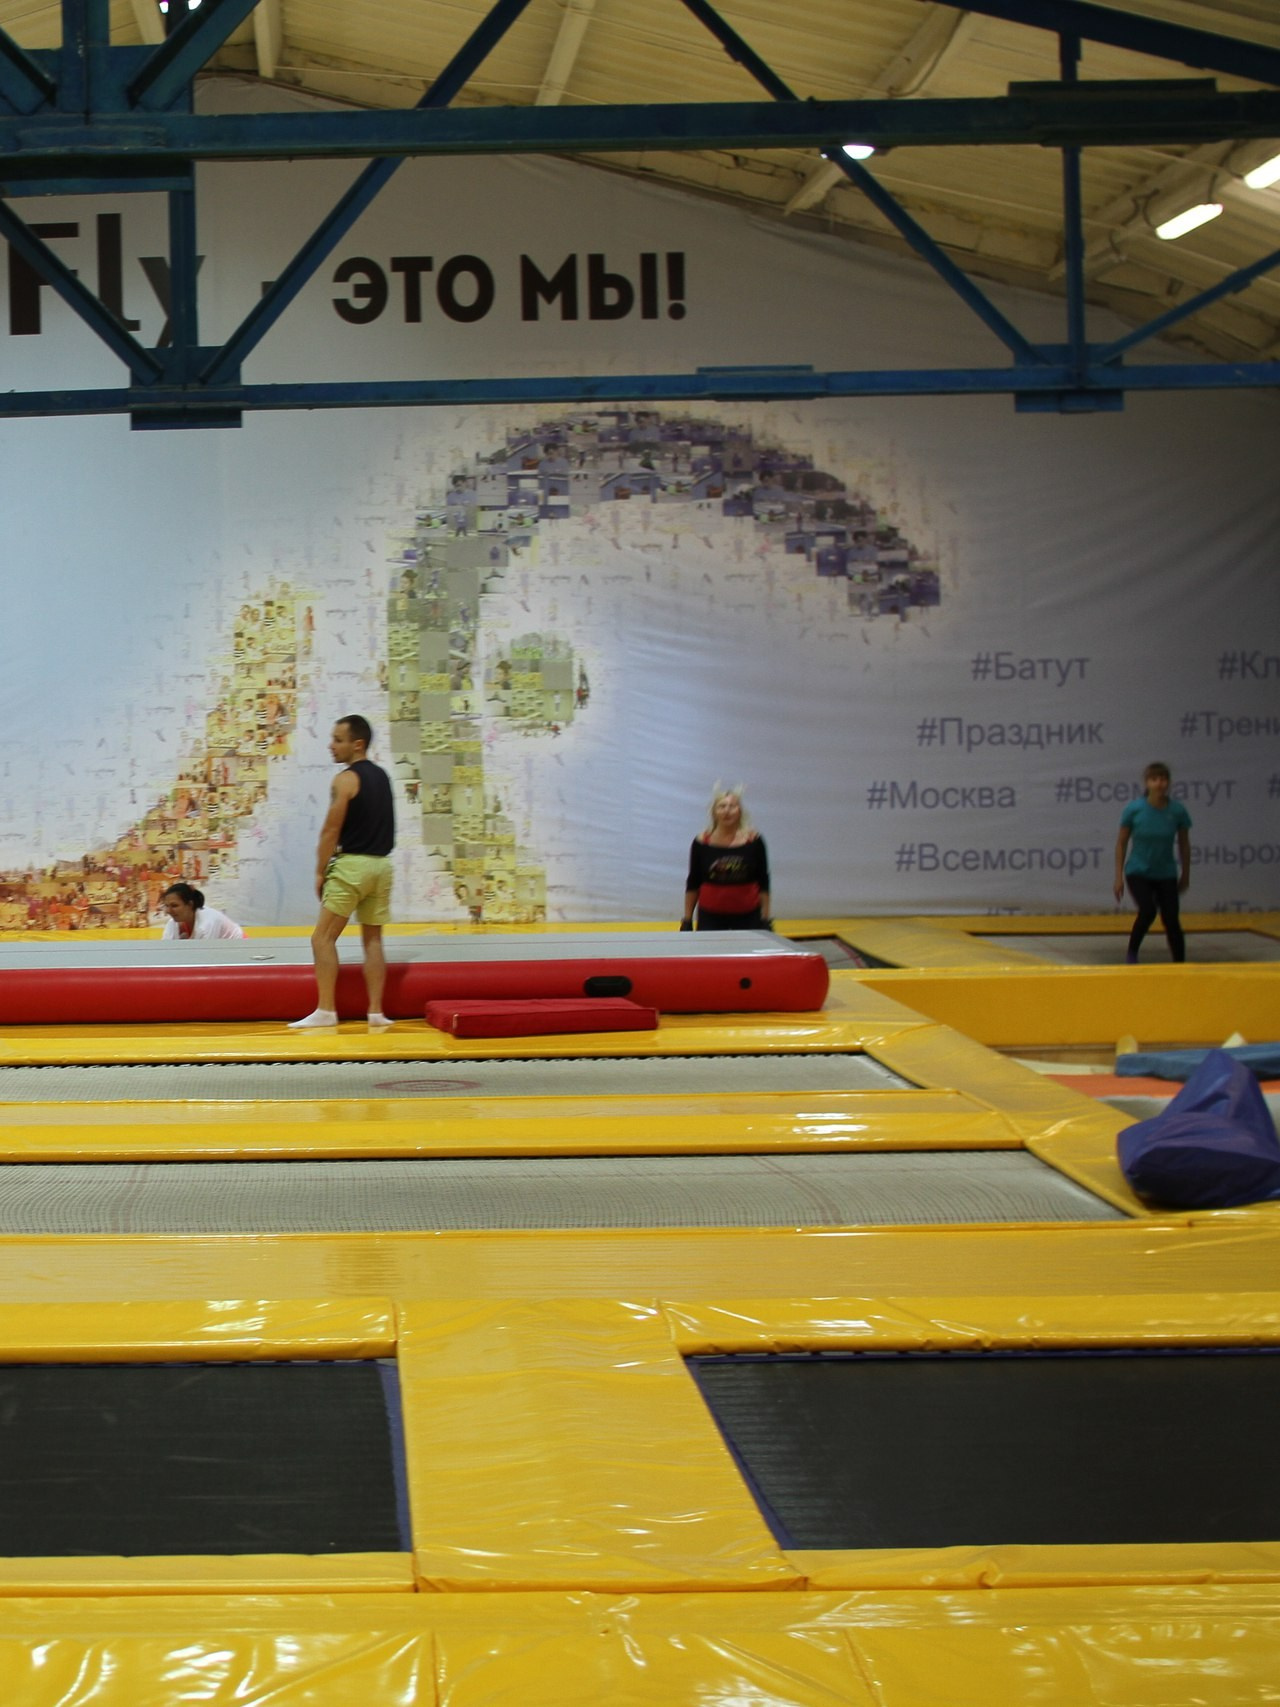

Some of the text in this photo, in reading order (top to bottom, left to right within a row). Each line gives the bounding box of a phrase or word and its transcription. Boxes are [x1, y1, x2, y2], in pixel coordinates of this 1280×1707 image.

[971, 651, 1090, 686] #Батут
[917, 717, 1104, 752] #Праздник
[867, 781, 1017, 809] #Москва
[896, 843, 1105, 876] #Всемспорт
